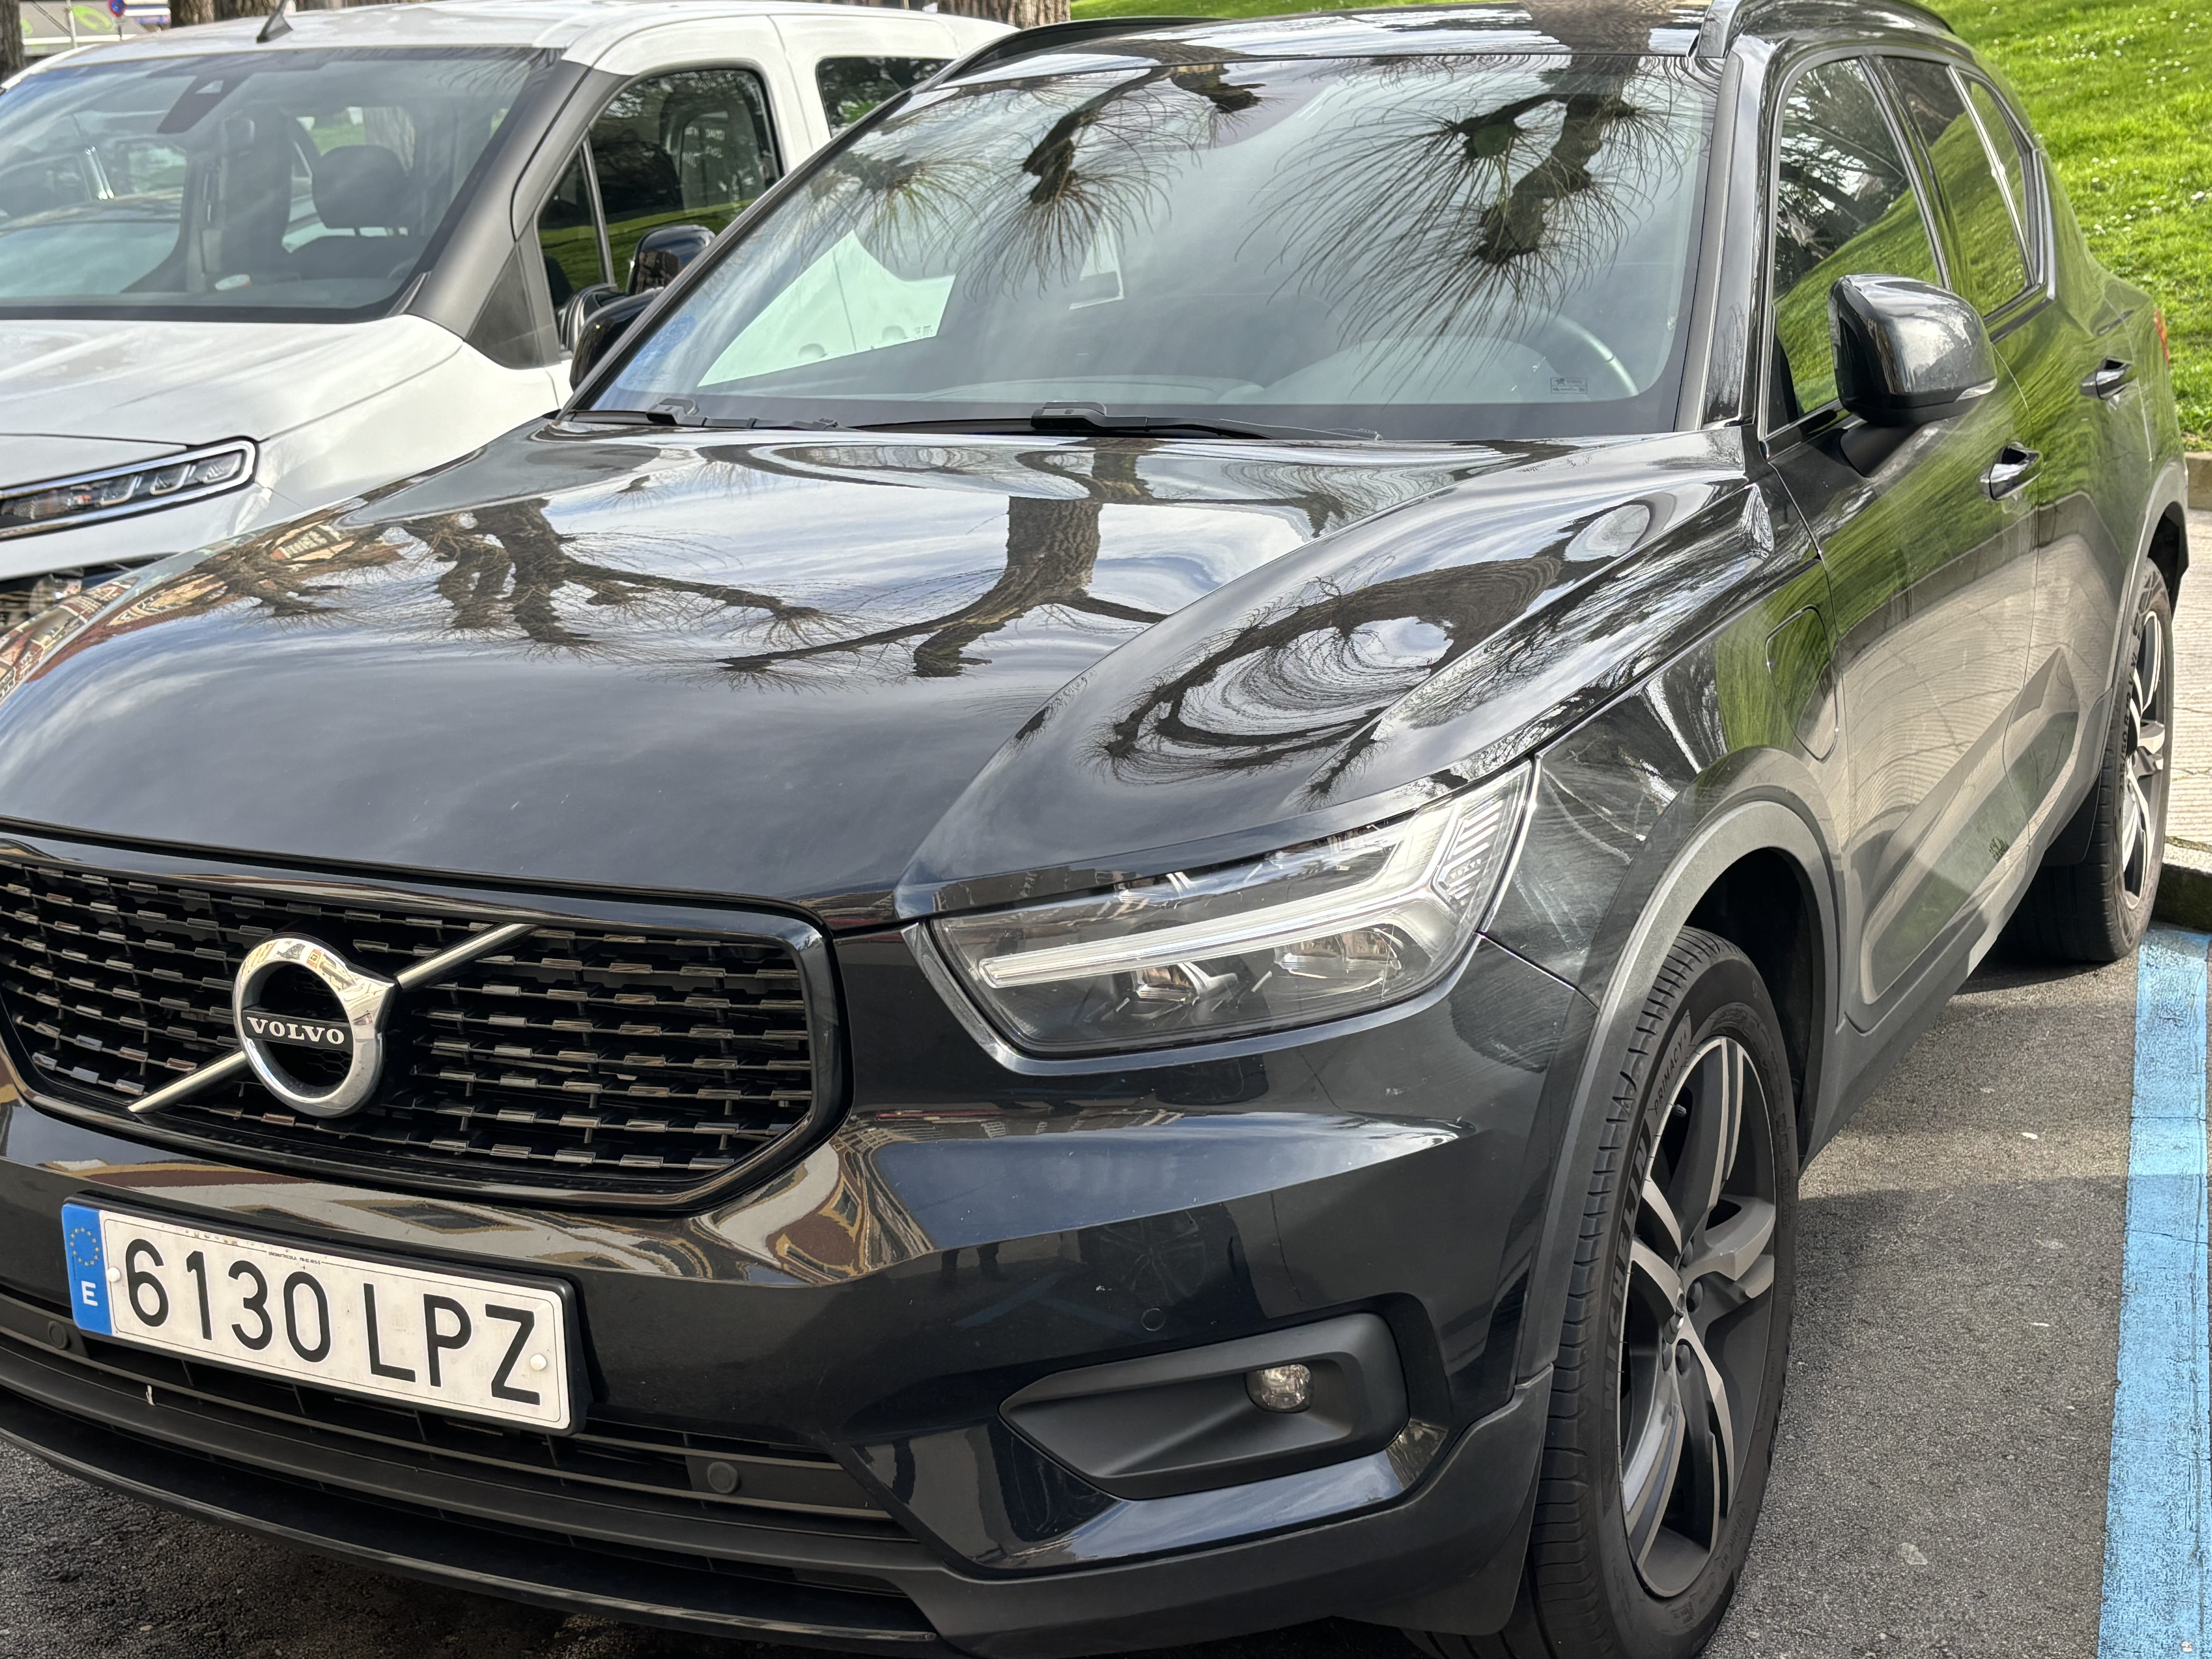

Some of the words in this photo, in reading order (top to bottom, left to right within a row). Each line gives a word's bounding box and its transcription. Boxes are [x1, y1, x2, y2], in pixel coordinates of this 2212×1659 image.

[247, 1017, 345, 1044] VOLVO
[1653, 1036, 1682, 1116] PRIMACY
[81, 1281, 98, 1307] E
[1603, 1136, 1647, 1412] MICHELIN
[125, 1238, 331, 1362] 6130
[363, 1283, 541, 1406] LPZ
